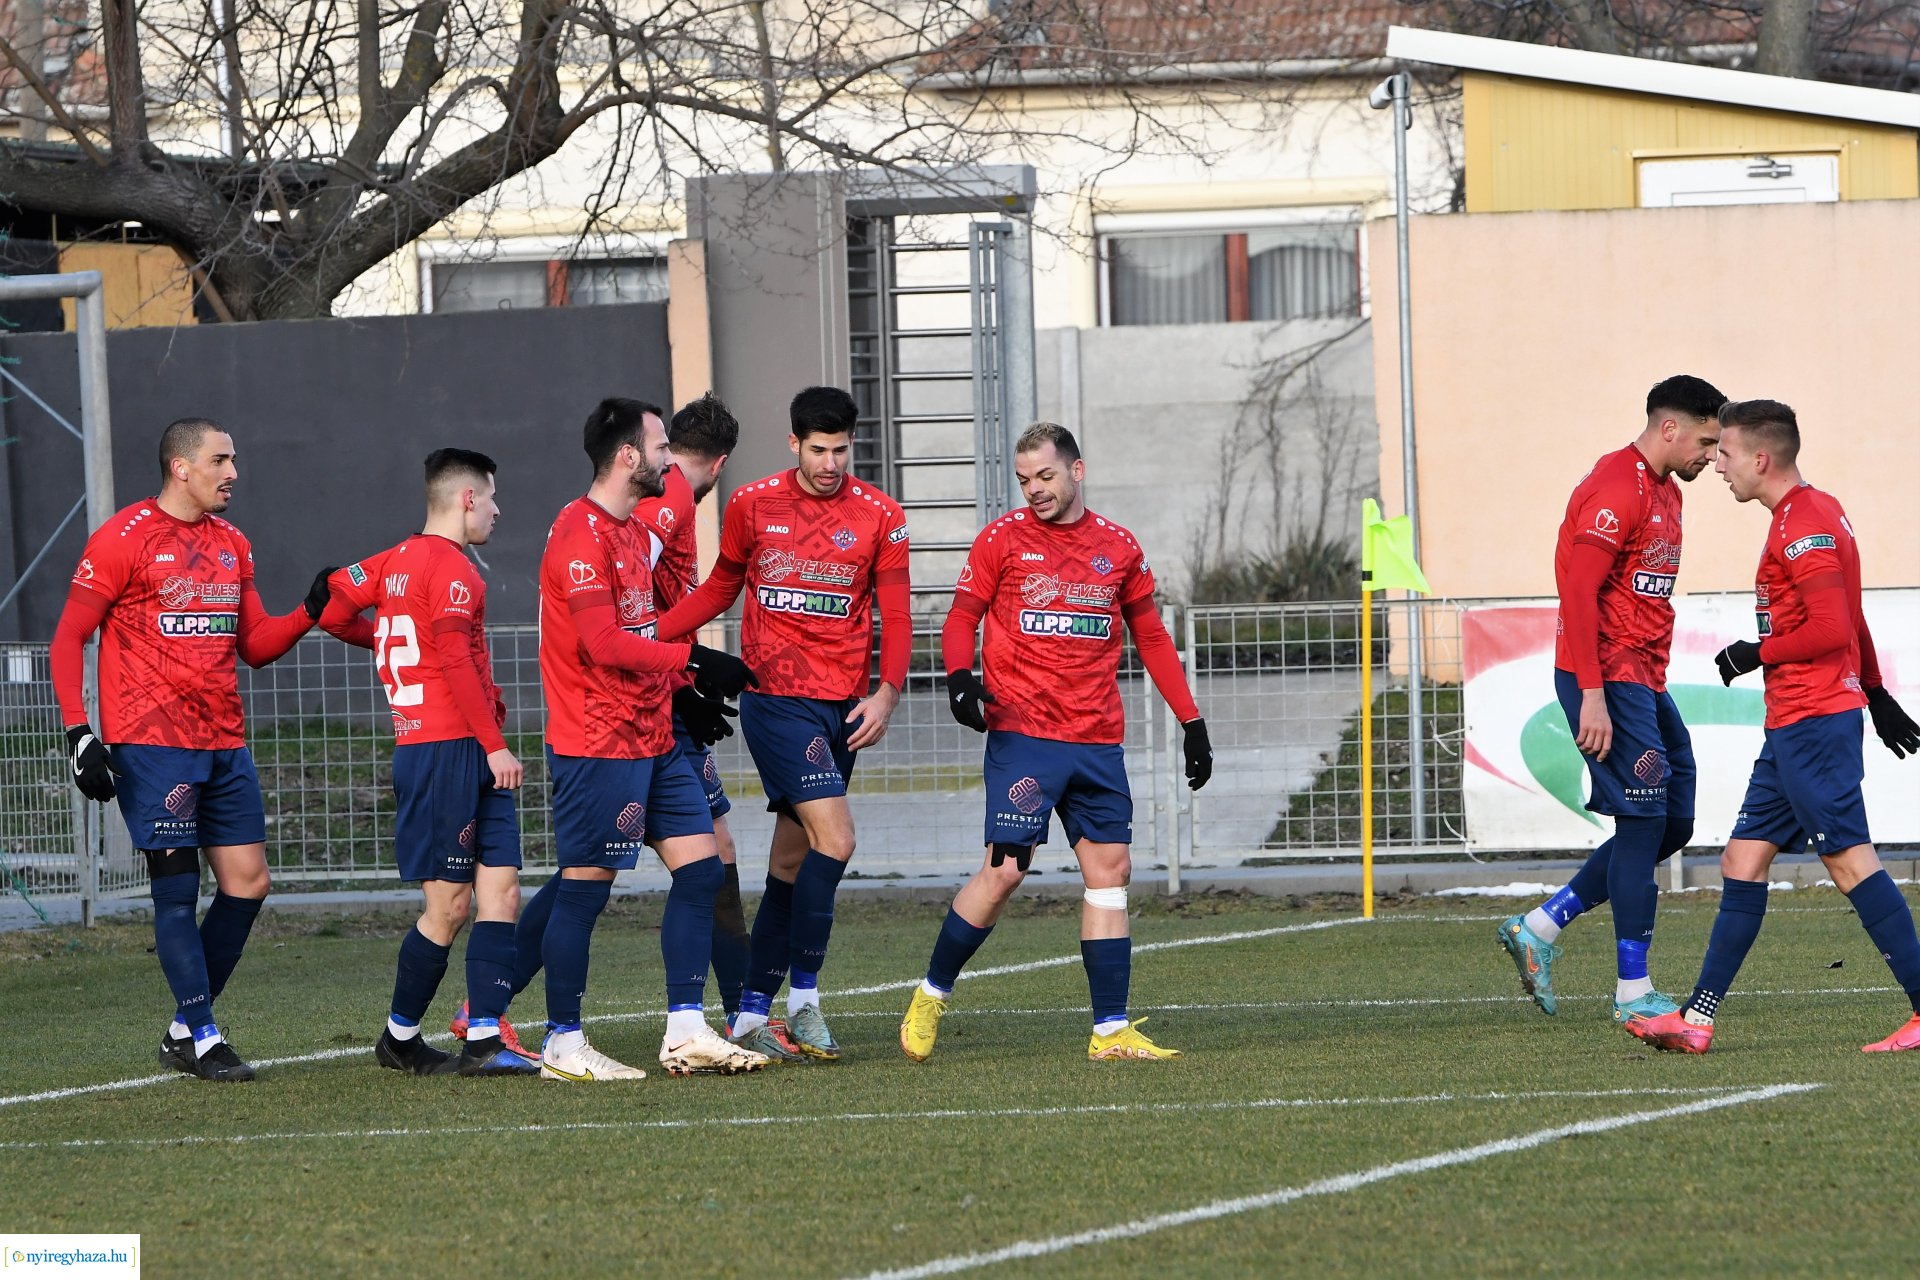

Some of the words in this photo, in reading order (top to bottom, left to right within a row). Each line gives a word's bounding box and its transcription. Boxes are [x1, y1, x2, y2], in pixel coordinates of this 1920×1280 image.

[766, 525, 789, 534] JAKO
[155, 554, 175, 562] JAKO
[1021, 552, 1045, 561] JAKO
[793, 559, 858, 579] REVESZ
[1636, 574, 1674, 594] TiPP
[1059, 582, 1116, 601] REVESZ
[182, 994, 205, 1007] JAKO
